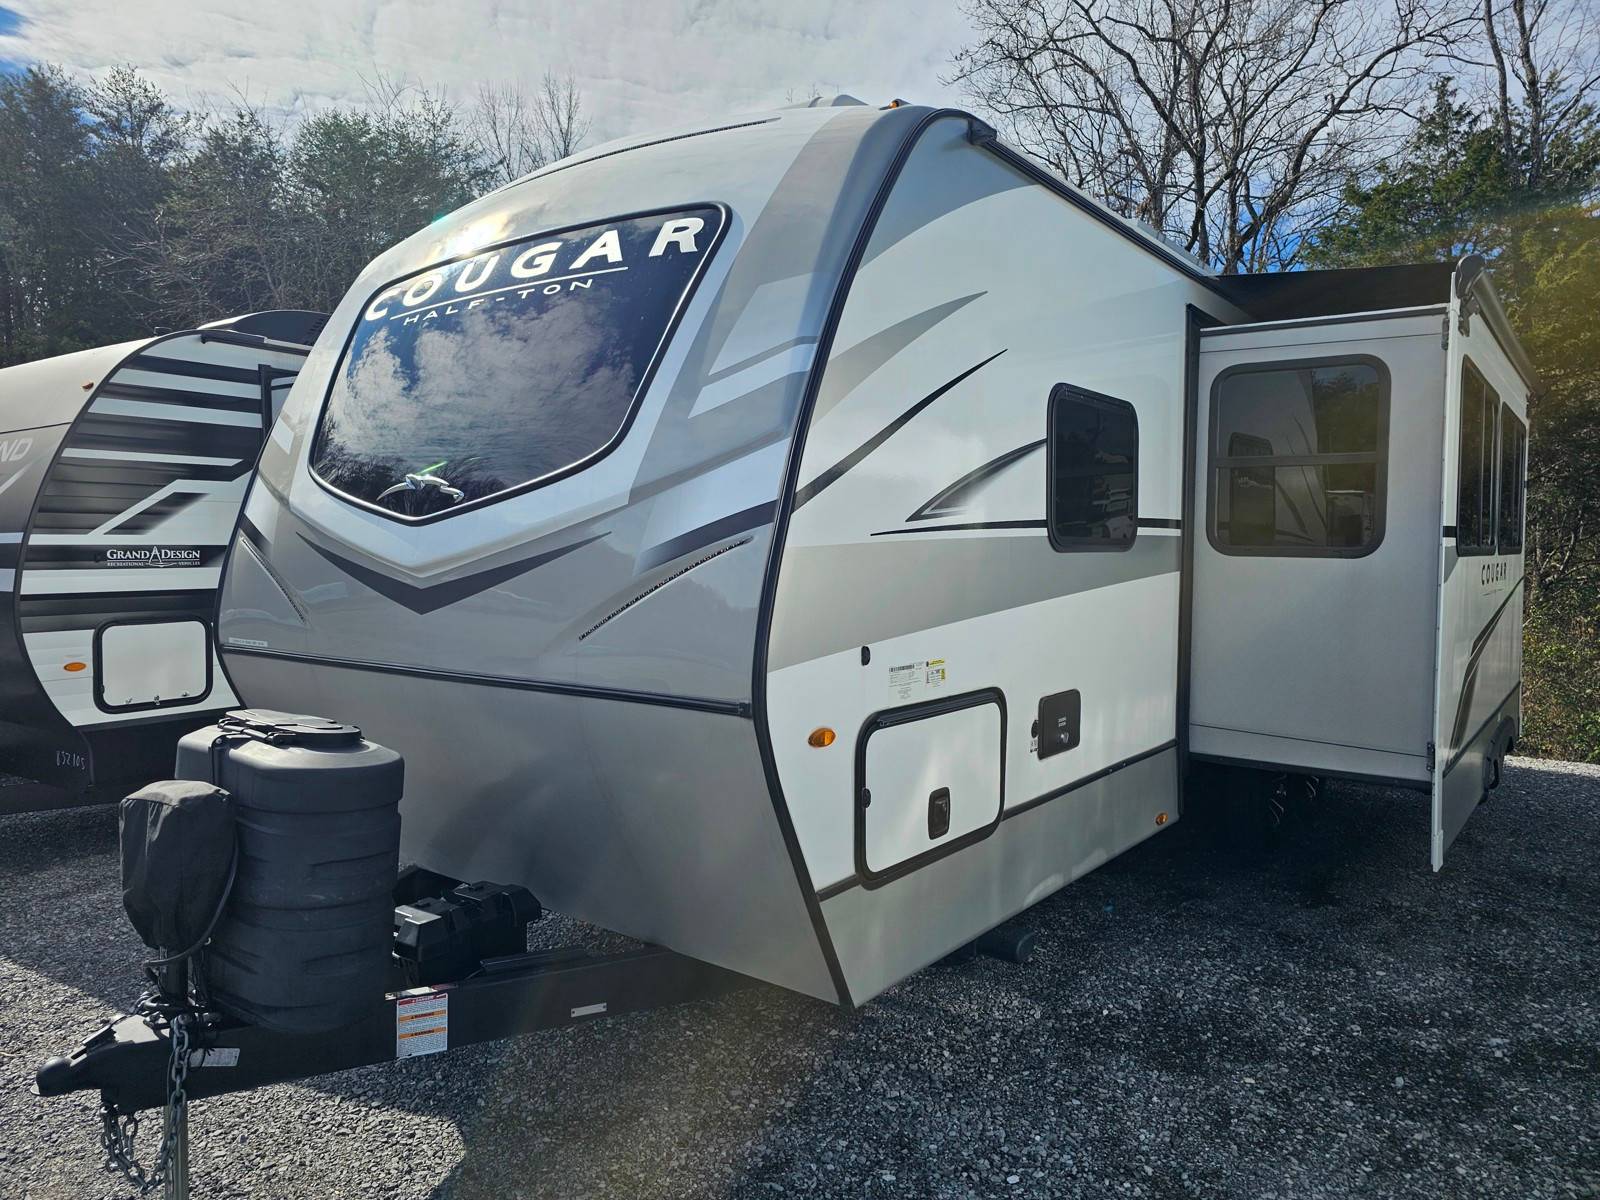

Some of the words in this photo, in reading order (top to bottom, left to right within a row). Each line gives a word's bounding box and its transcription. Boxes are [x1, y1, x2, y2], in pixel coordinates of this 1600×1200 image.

[364, 217, 704, 321] COUGAR
[402, 278, 594, 326] HALF-TON
[106, 549, 150, 559] GRAND
[161, 549, 201, 559] DESIGN
[1481, 562, 1507, 586] COUGAR
